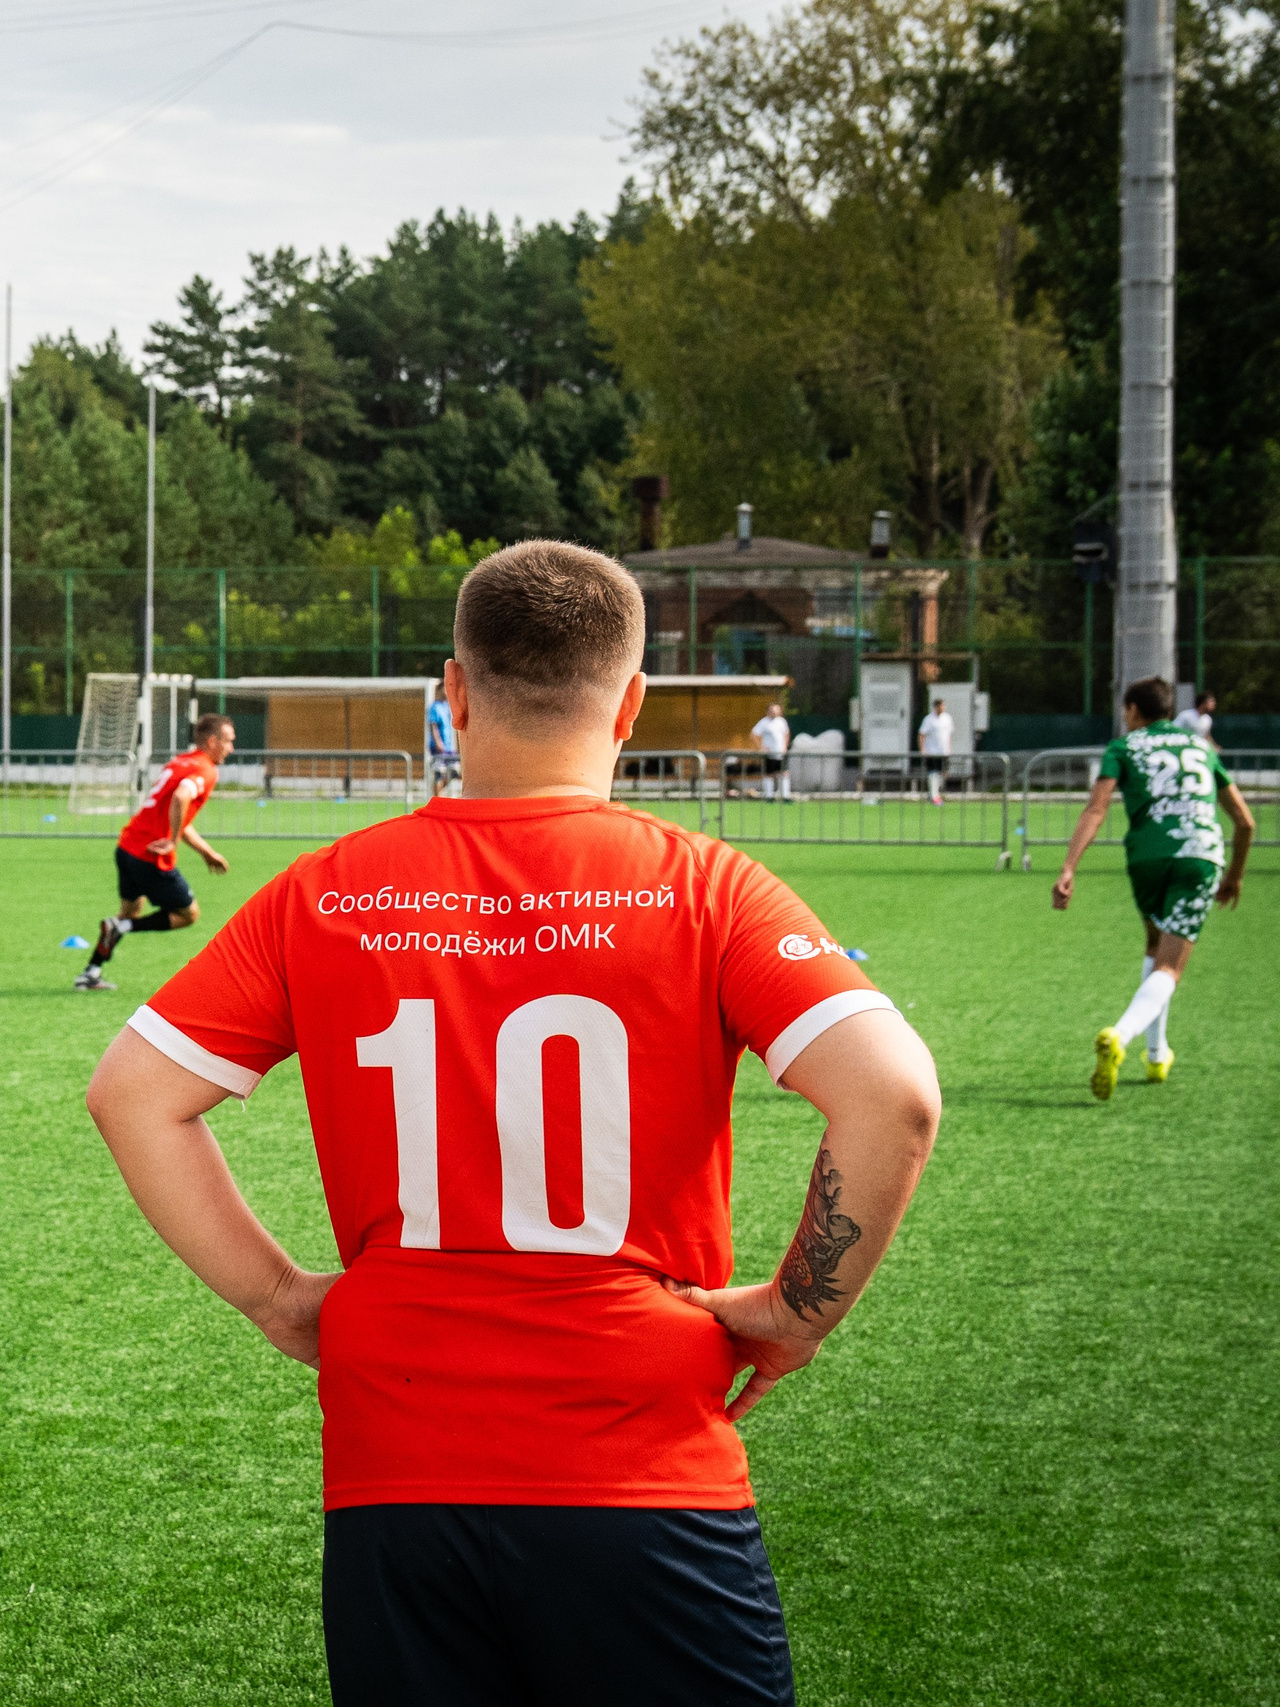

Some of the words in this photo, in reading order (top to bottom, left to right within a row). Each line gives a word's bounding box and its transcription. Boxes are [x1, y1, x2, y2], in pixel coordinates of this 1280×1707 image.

[1146, 748, 1214, 797] 25
[317, 885, 512, 915] Сообщество
[519, 883, 675, 912] активной
[360, 930, 526, 958] молодёжи
[534, 923, 616, 953] ОМК
[355, 994, 631, 1256] 10
